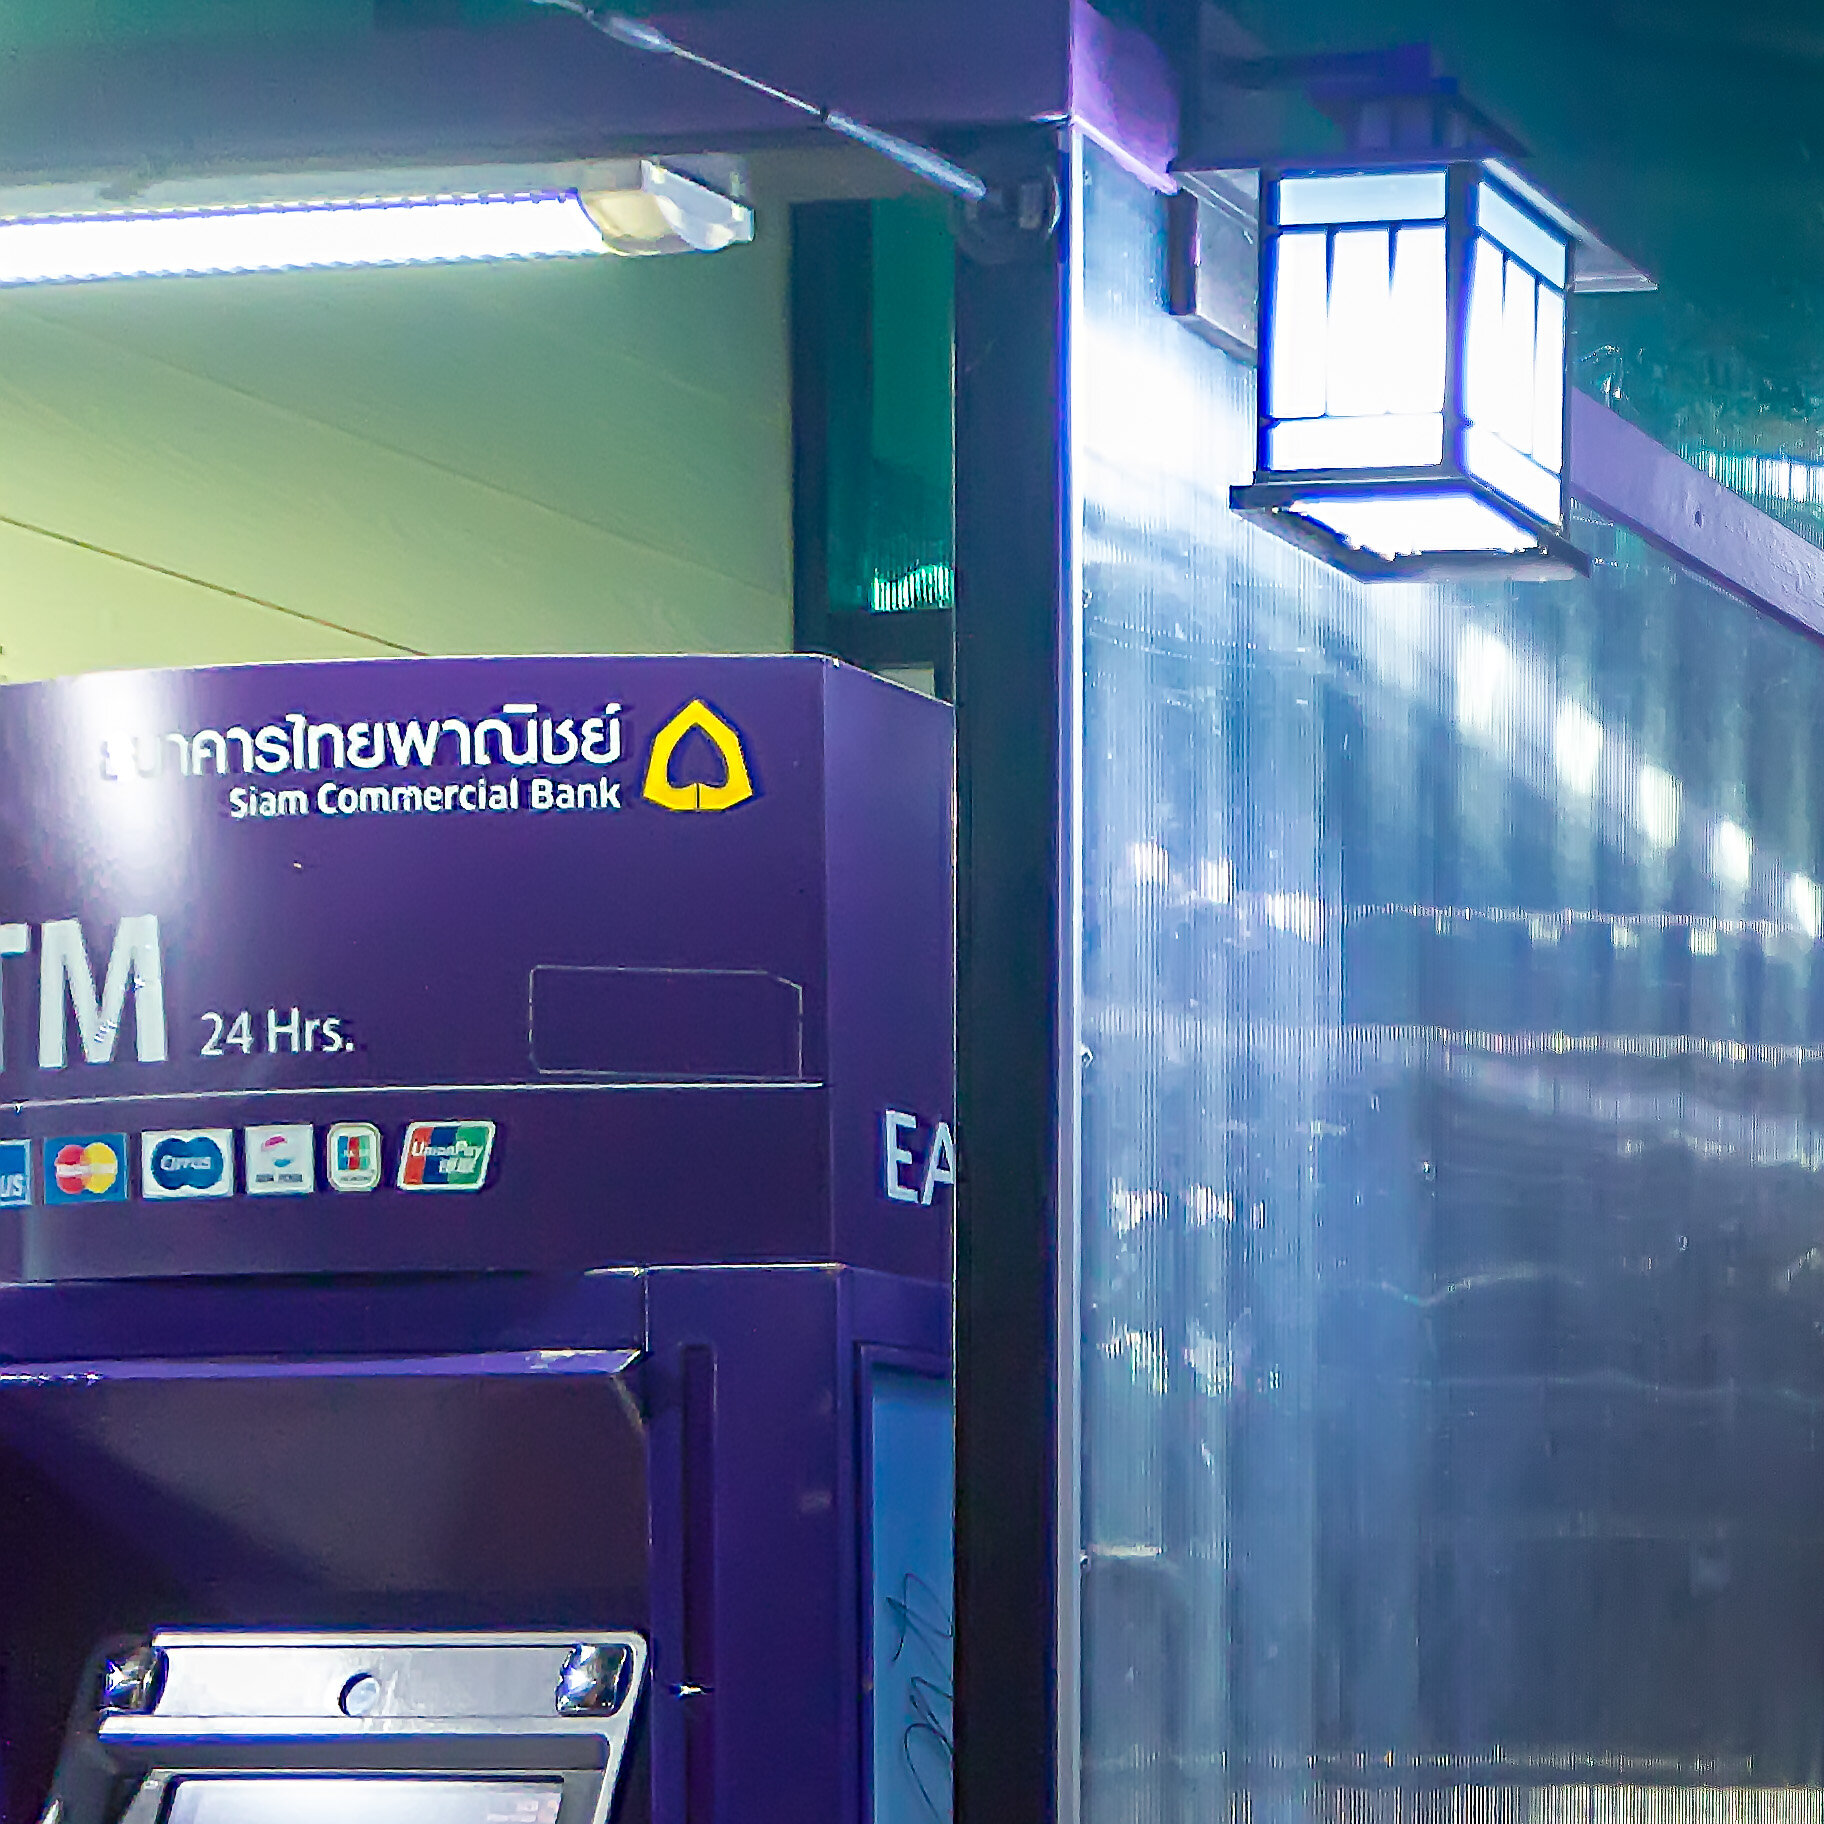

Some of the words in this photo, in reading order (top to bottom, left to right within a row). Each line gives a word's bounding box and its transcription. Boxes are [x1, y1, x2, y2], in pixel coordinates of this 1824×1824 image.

[229, 785, 308, 819] Siam
[317, 778, 518, 816] Commercial
[531, 778, 622, 811] Bank
[200, 1010, 254, 1056] 24
[266, 1006, 355, 1055] Hrs.
